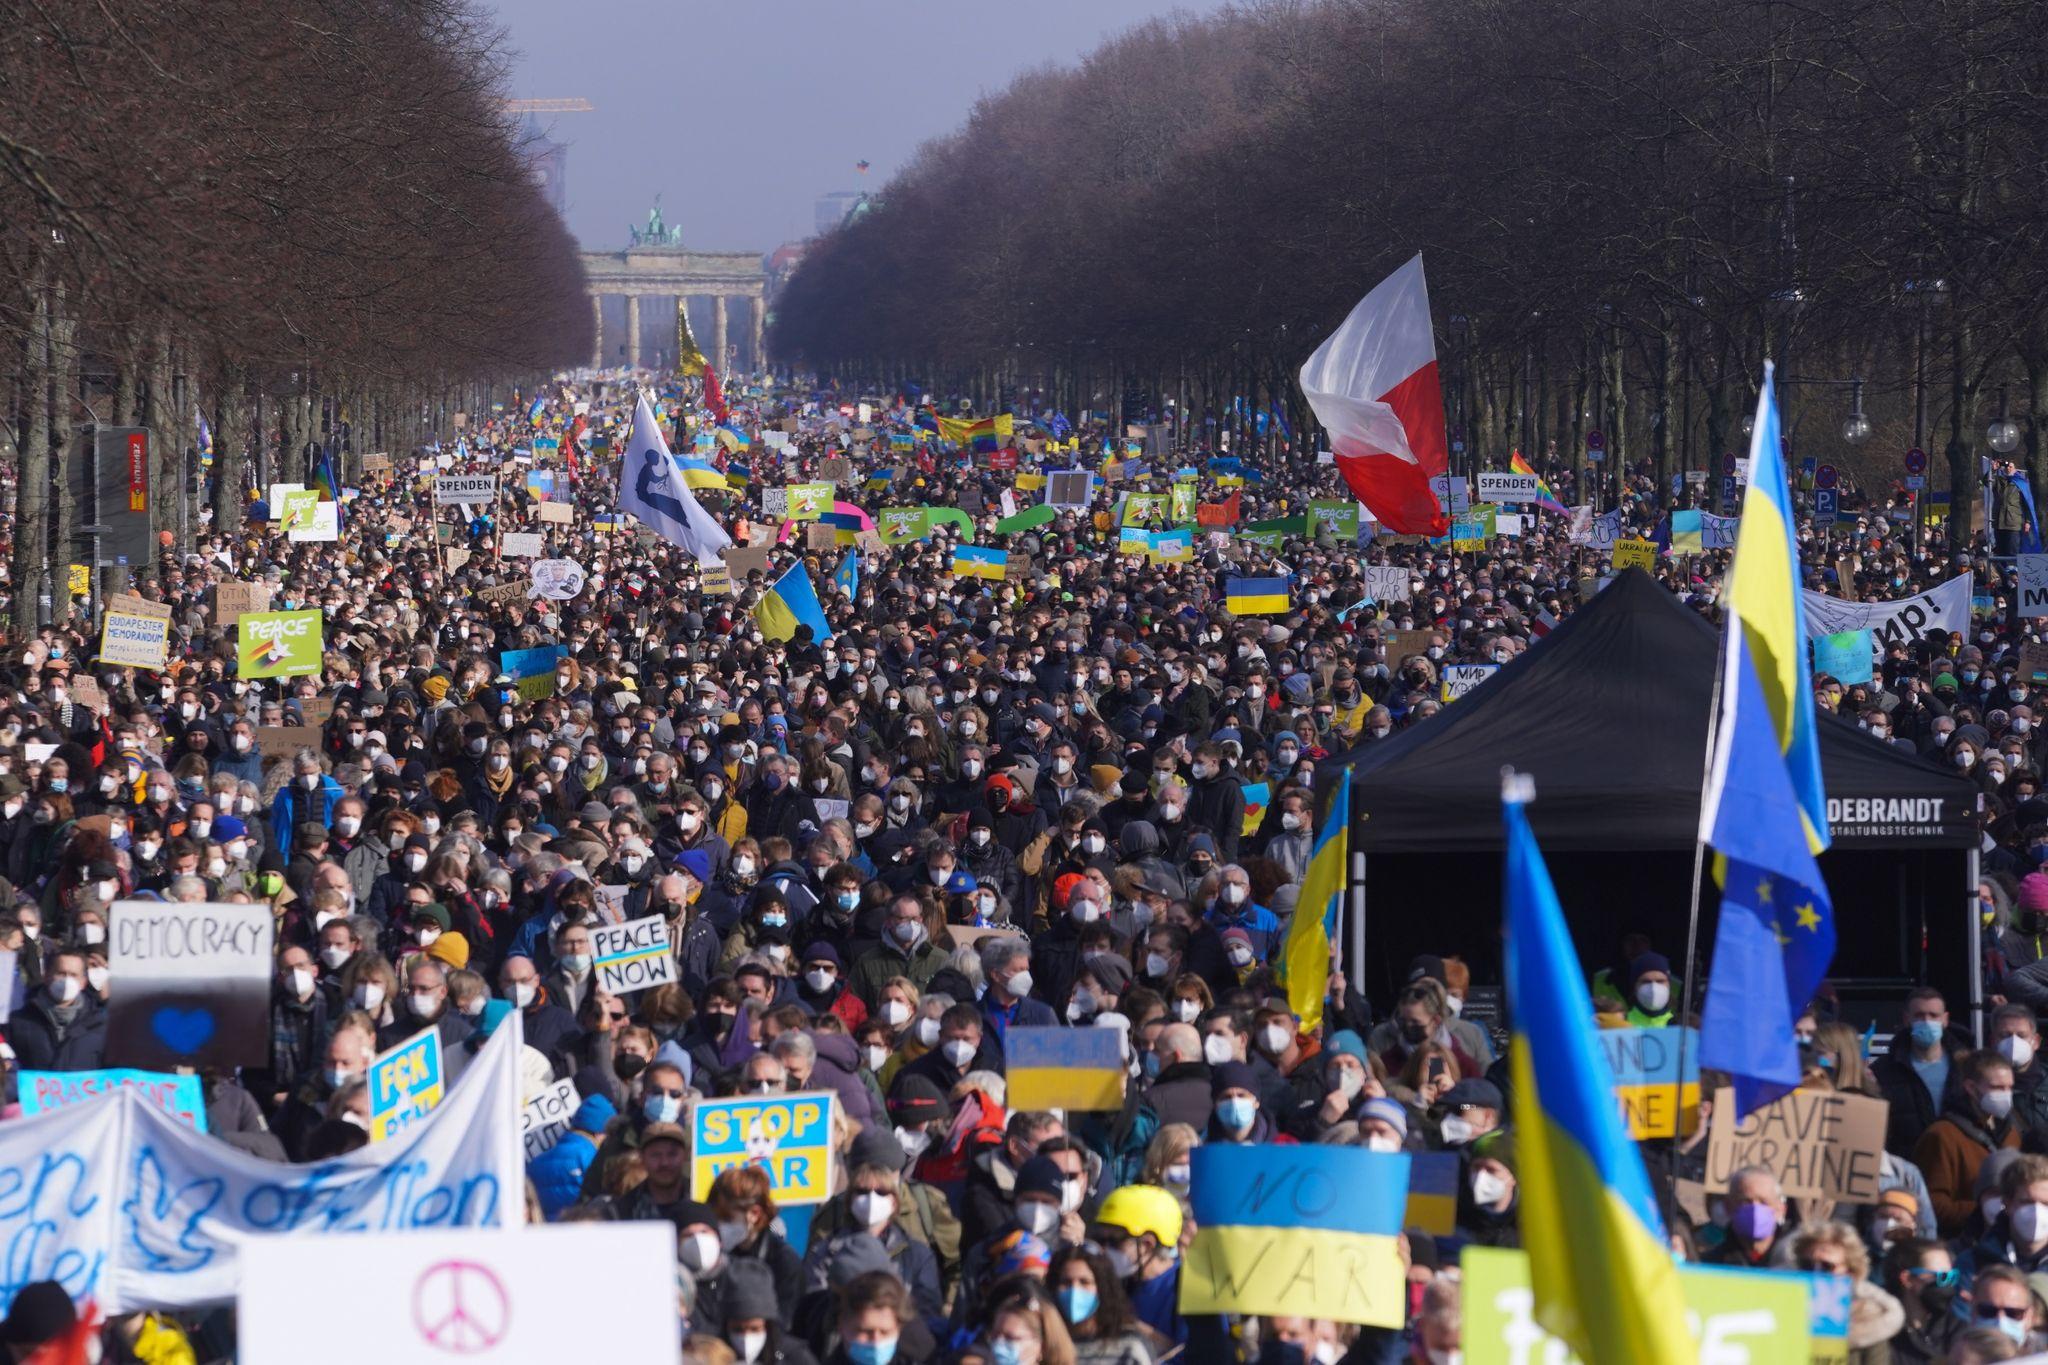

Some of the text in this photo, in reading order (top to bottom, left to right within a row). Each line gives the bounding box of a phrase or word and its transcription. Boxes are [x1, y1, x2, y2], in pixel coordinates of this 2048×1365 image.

[440, 480, 492, 491] SPENDEN
[1481, 478, 1536, 489] SPENDEN
[1723, 478, 1733, 496] P
[793, 488, 829, 500] PEACE
[1818, 491, 1831, 511] P
[885, 511, 923, 524] PEACE
[1313, 507, 1355, 520] PEACE
[1619, 542, 1658, 554] UKRAINE
[1368, 567, 1407, 585] STOP
[1369, 584, 1401, 600] WAR
[109, 616, 164, 632] BUDAPESTER
[246, 616, 314, 640] PEACE
[107, 628, 163, 644] MEMORANDUM
[1826, 797, 1945, 824] DEBRANDT
[1829, 825, 1945, 837] STALTUNGSTECHNIK
[117, 917, 267, 961] DEMOCRACY
[594, 921, 665, 957] PEACE
[603, 955, 668, 991] NOW
[379, 1045, 430, 1103] FCK
[703, 1103, 821, 1146] STOP
[1733, 1093, 1846, 1143] SAVE
[1711, 1138, 1876, 1198] UKRAINE
[1236, 1165, 1339, 1218] NO
[1205, 1237, 1376, 1309] WAR
